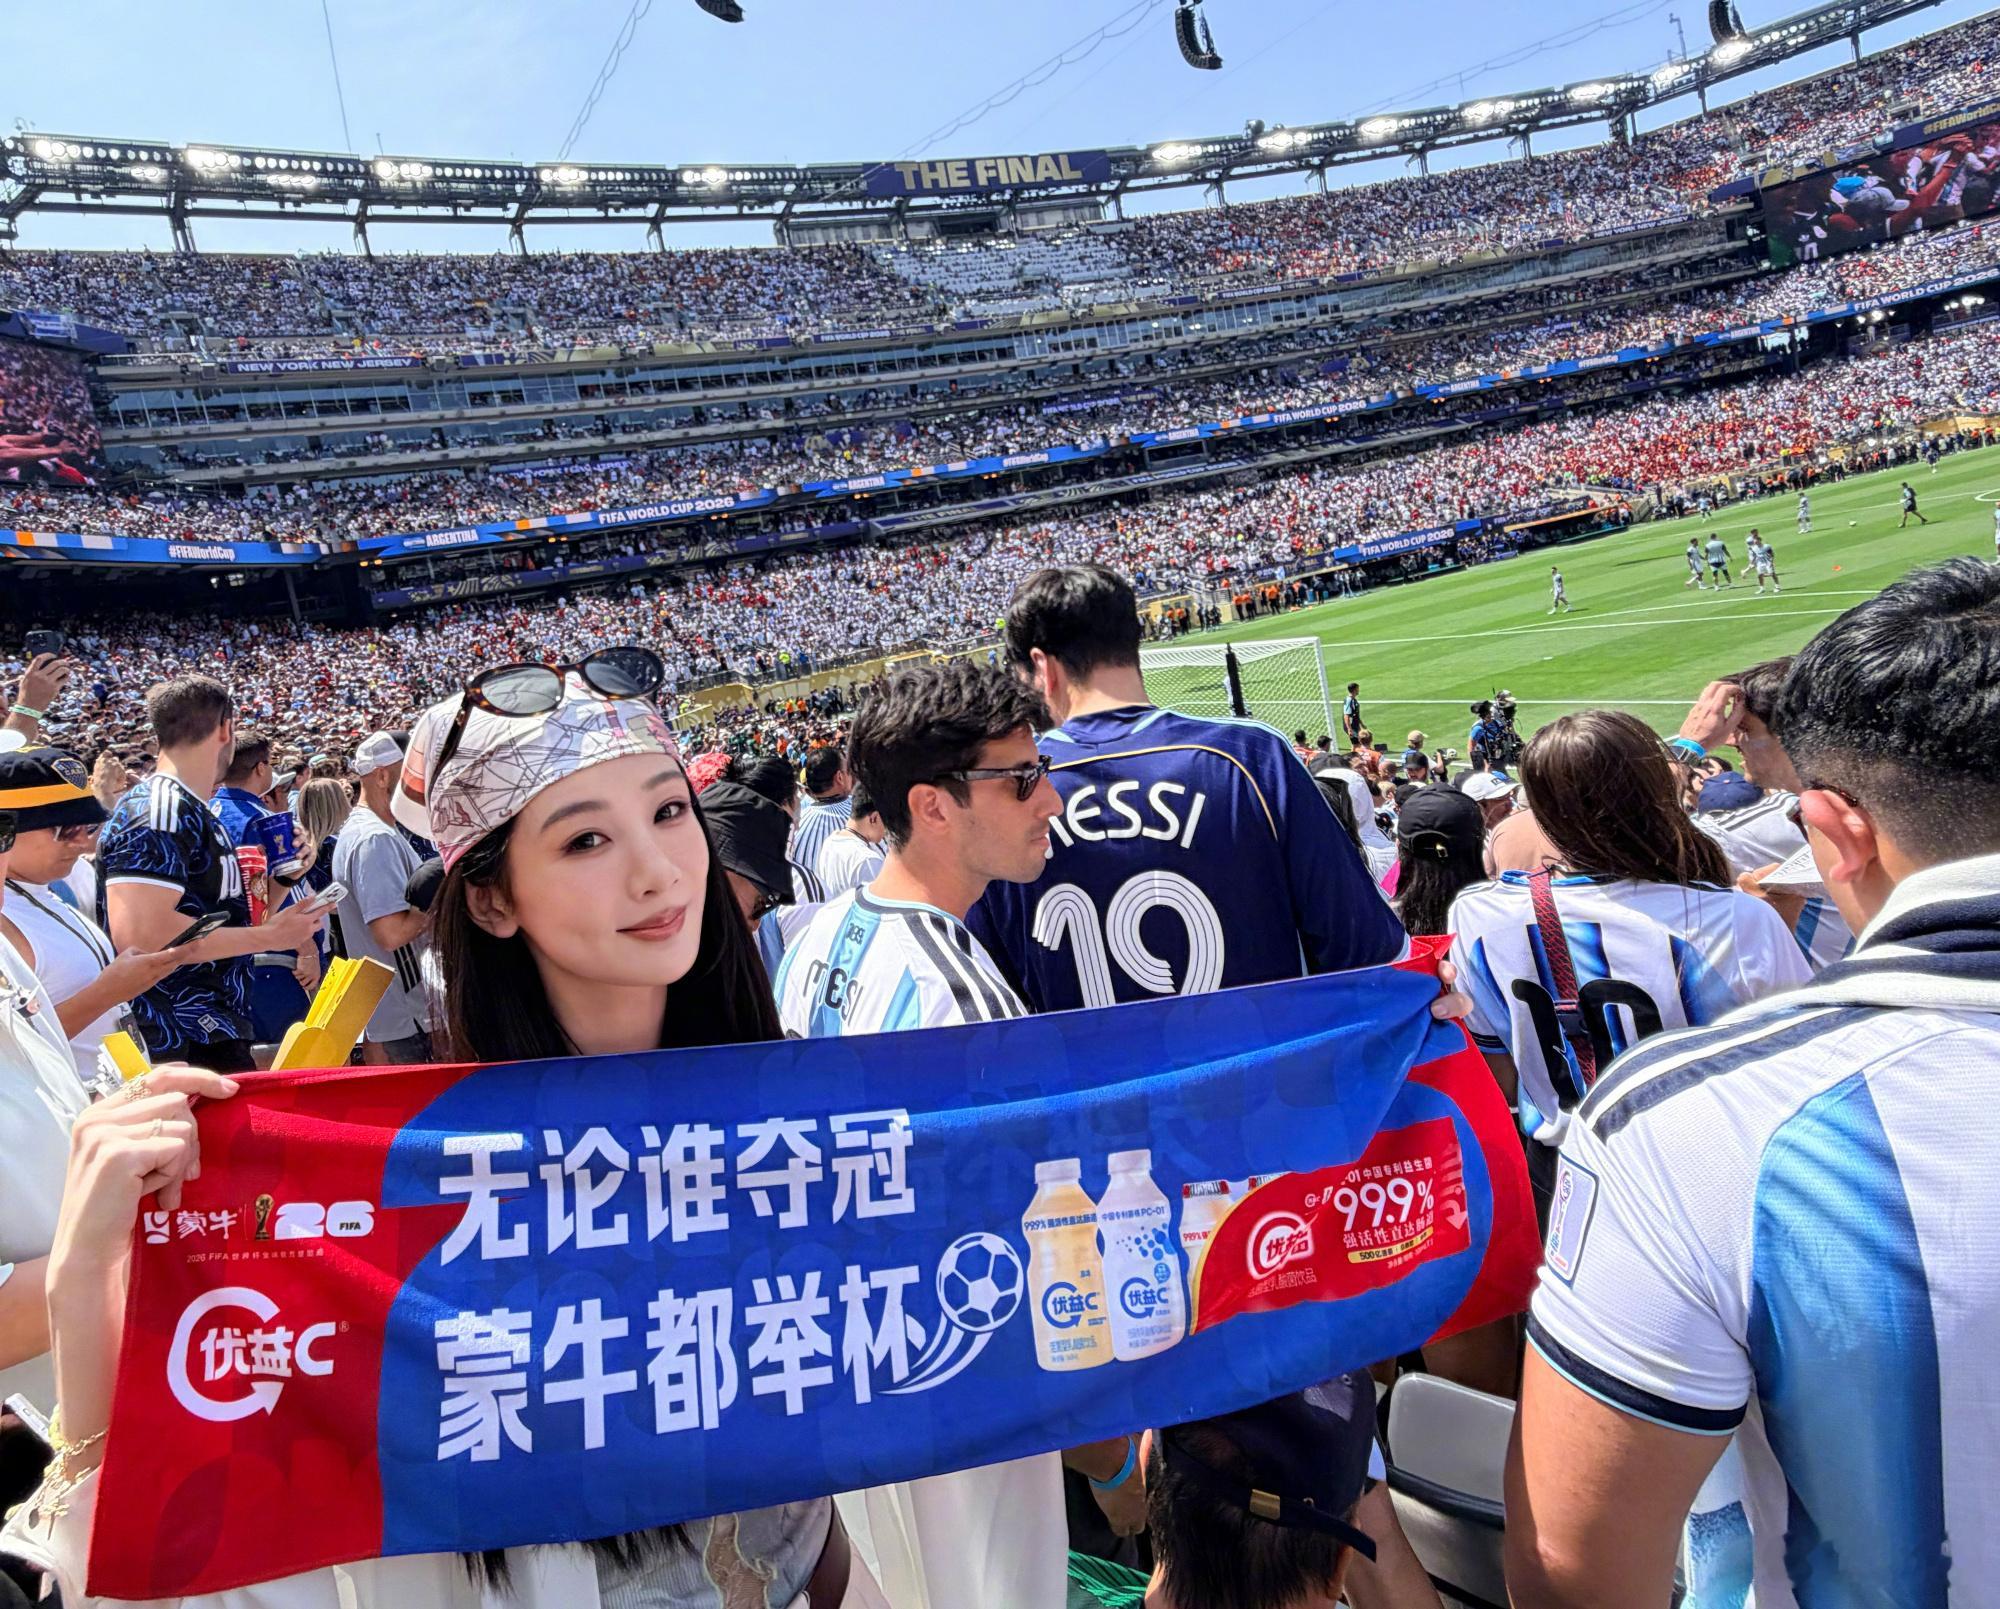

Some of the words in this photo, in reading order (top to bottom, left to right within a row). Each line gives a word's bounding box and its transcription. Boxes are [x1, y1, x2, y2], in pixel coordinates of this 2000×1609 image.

[894, 160, 972, 190] THE
[975, 154, 1083, 186] FINAL
[1854, 296, 1882, 312] FIFA
[1880, 287, 1925, 304] WORLD
[1926, 279, 1954, 292] CUP
[1953, 268, 2000, 287] 2026
[237, 362, 274, 372] NEW
[276, 362, 319, 371] YORK
[321, 361, 354, 370] NEW
[356, 358, 412, 369] JERSEY
[1273, 412, 1293, 424] FIFA
[1292, 407, 1322, 420] WORLD
[1322, 404, 1338, 415] CUP
[1338, 400, 1367, 413] 2026
[599, 512, 627, 525] FIFA
[626, 505, 670, 520] WORLD
[670, 502, 694, 515] CUP
[694, 496, 735, 512] 2026
[425, 529, 479, 547] ARGENTINA
[1362, 544, 1381, 557] FIFA
[1380, 538, 1410, 553] WORLD
[1410, 534, 1427, 548] CUP
[1427, 528, 1454, 544] 2026
[168, 544, 236, 562] #FIFAWorldCup
[219, 854, 244, 902] 10
[1363, 1157, 1433, 1179] 中国专利益生菌
[439, 1108, 916, 1266] 无论谁夺冠
[1333, 1177, 1435, 1232] 99.9%
[176, 1209, 237, 1240] 蒙牛
[339, 1221, 362, 1231] FIFA
[187, 1253, 206, 1263] 2026
[208, 1252, 229, 1261] FIFA
[1052, 1292, 1099, 1316] 优益C
[1128, 1287, 1169, 1307] 优益C
[199, 1321, 336, 1382] 优益C
[434, 1264, 926, 1462] 蒙牛都举杯
